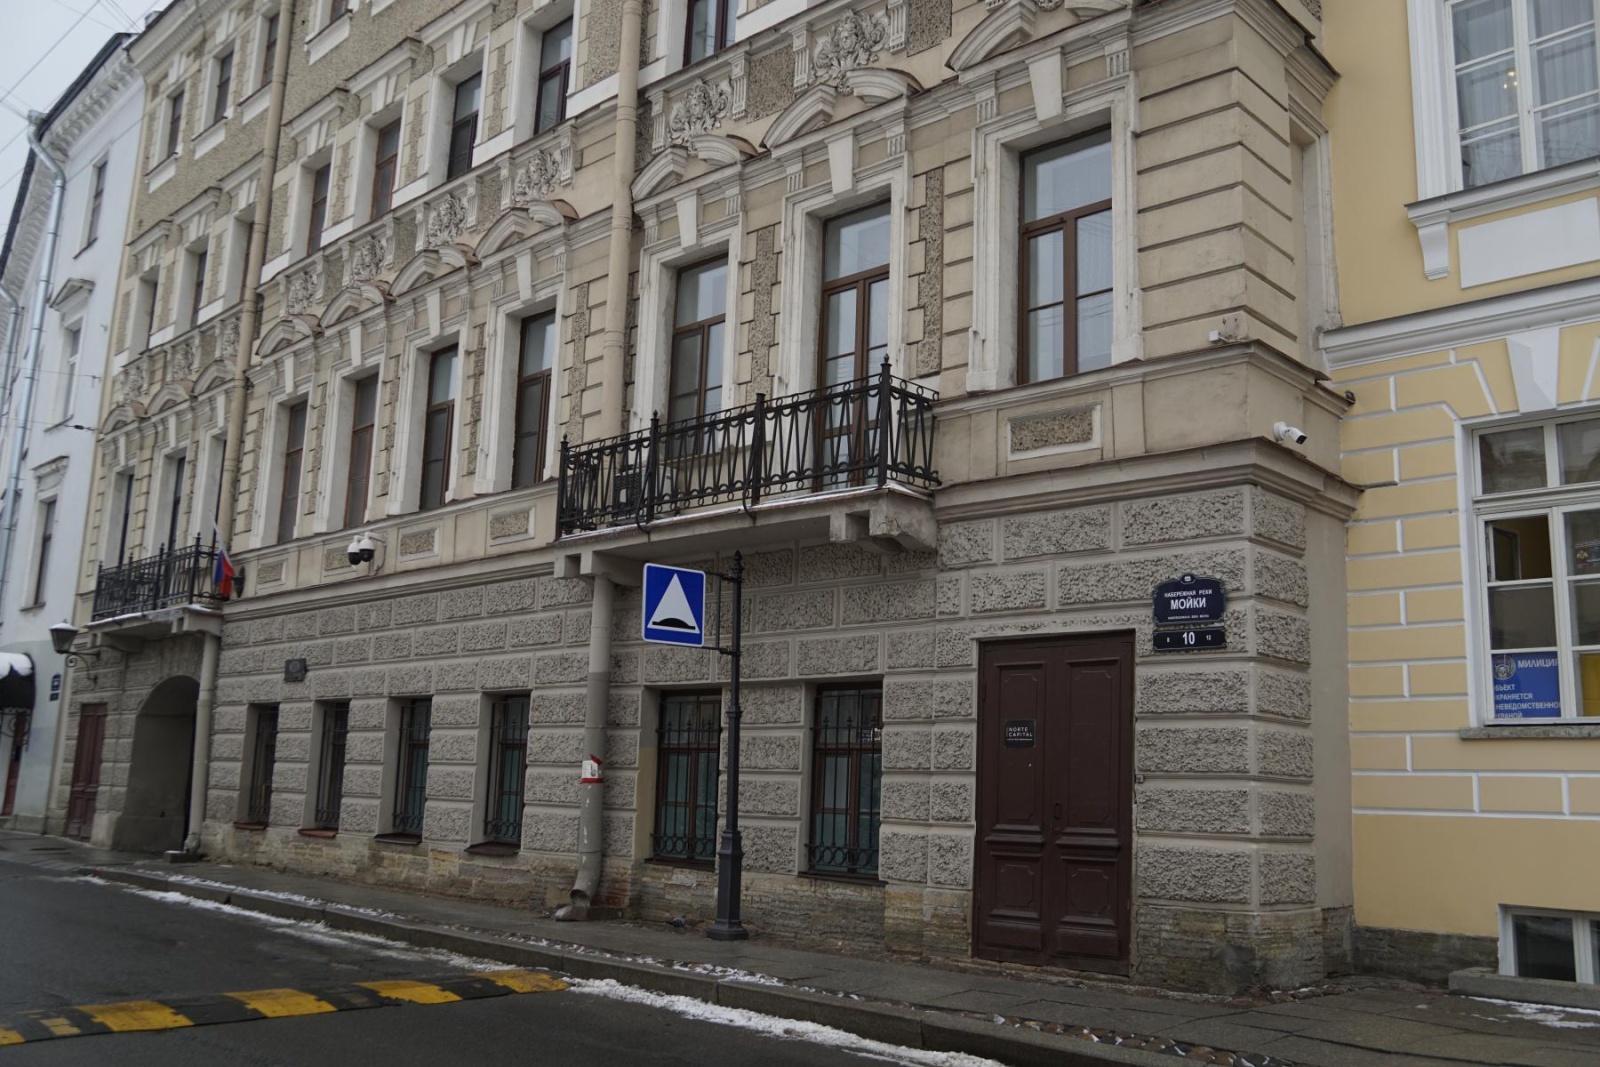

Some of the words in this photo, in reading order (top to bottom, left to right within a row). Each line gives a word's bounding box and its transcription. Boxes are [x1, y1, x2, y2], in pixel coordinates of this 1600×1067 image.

[1170, 597, 1206, 610] МОЙКИ
[1182, 631, 1195, 645] 10
[1495, 702, 1560, 711] НЕВЕДОМСТВЕННО
